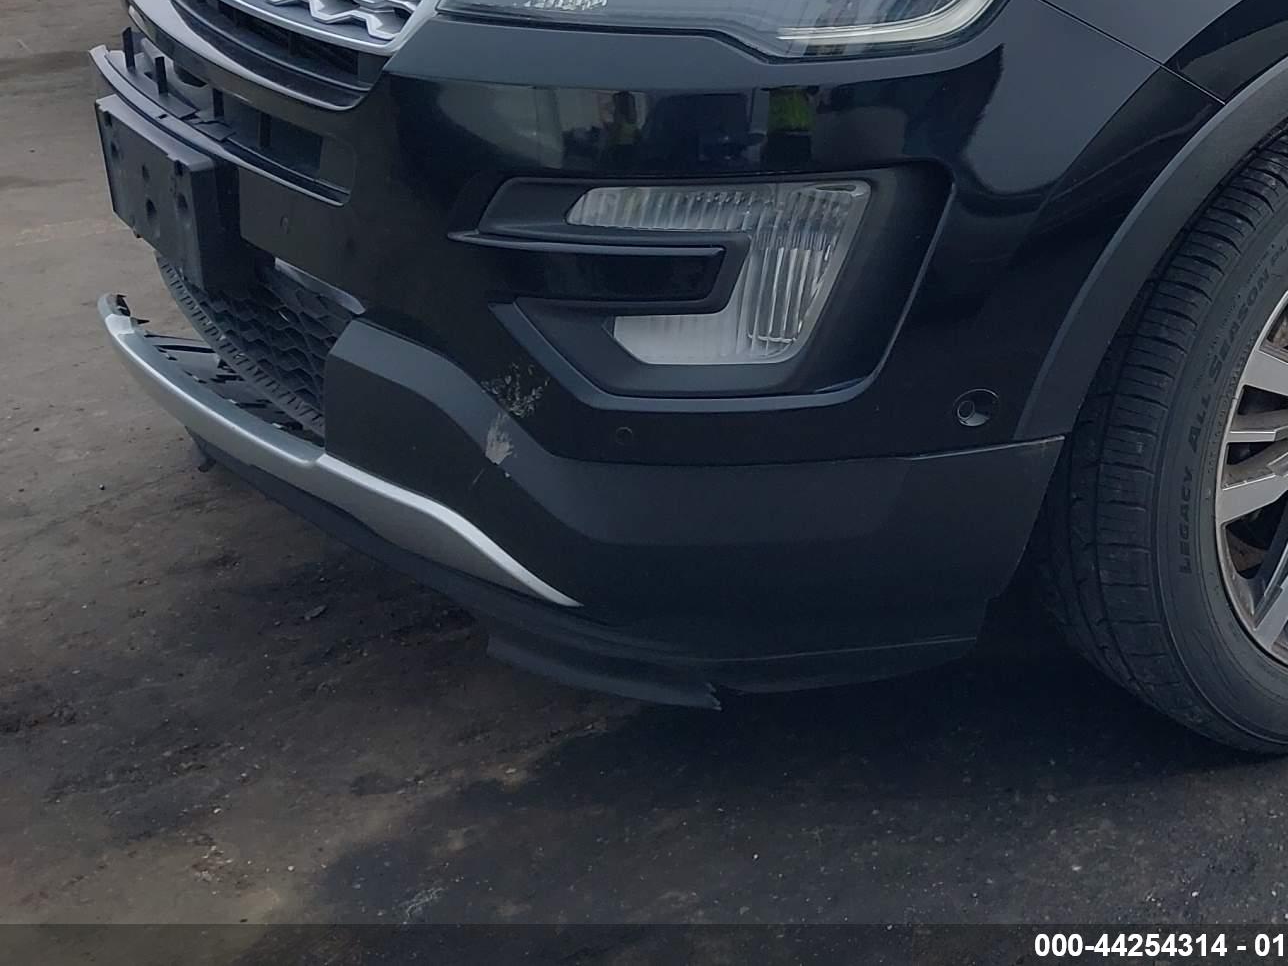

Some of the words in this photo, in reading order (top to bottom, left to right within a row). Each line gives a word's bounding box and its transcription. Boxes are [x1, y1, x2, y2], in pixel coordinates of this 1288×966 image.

[1180, 465, 1193, 574] LEGACY
[1189, 393, 1212, 453] ALL
[1208, 268, 1269, 383] SEASON
